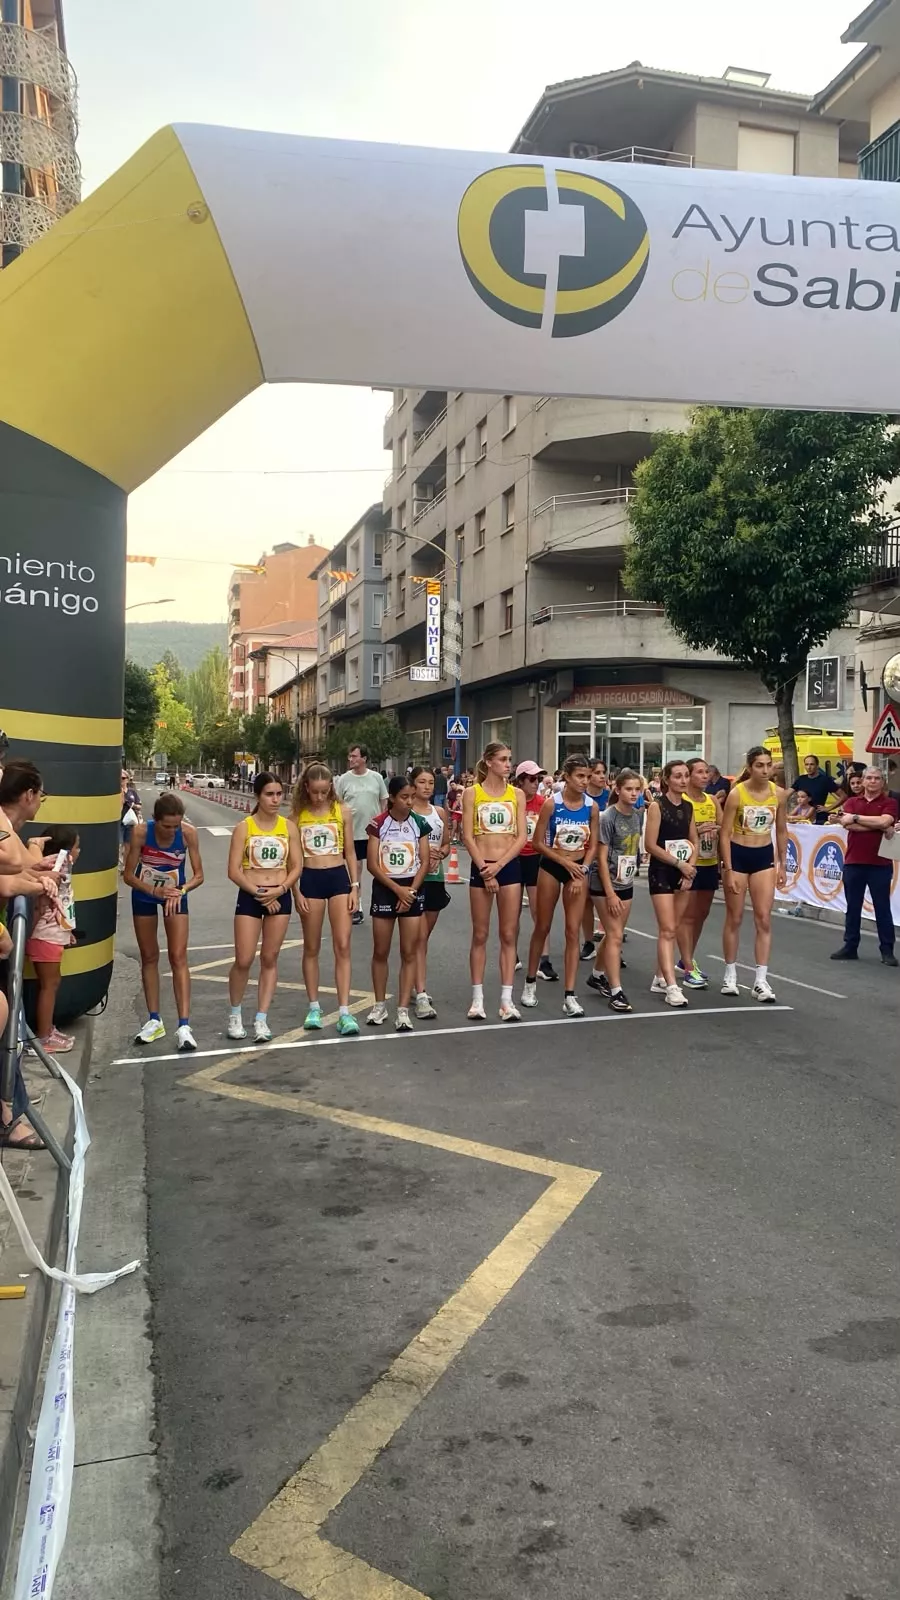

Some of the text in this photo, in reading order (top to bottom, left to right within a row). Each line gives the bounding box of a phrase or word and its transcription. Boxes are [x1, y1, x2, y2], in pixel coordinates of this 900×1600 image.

[427, 596, 439, 667] OLIMPIC
[574, 693, 603, 706] BAZAR
[604, 691, 638, 705] REGALO
[489, 812, 505, 825] 80
[754, 814, 767, 826] 79
[313, 834, 327, 848] 87
[564, 833, 580, 844] 81
[701, 839, 713, 851] 89
[261, 846, 278, 860] 88
[389, 852, 405, 866] 93
[676, 849, 688, 861] 92
